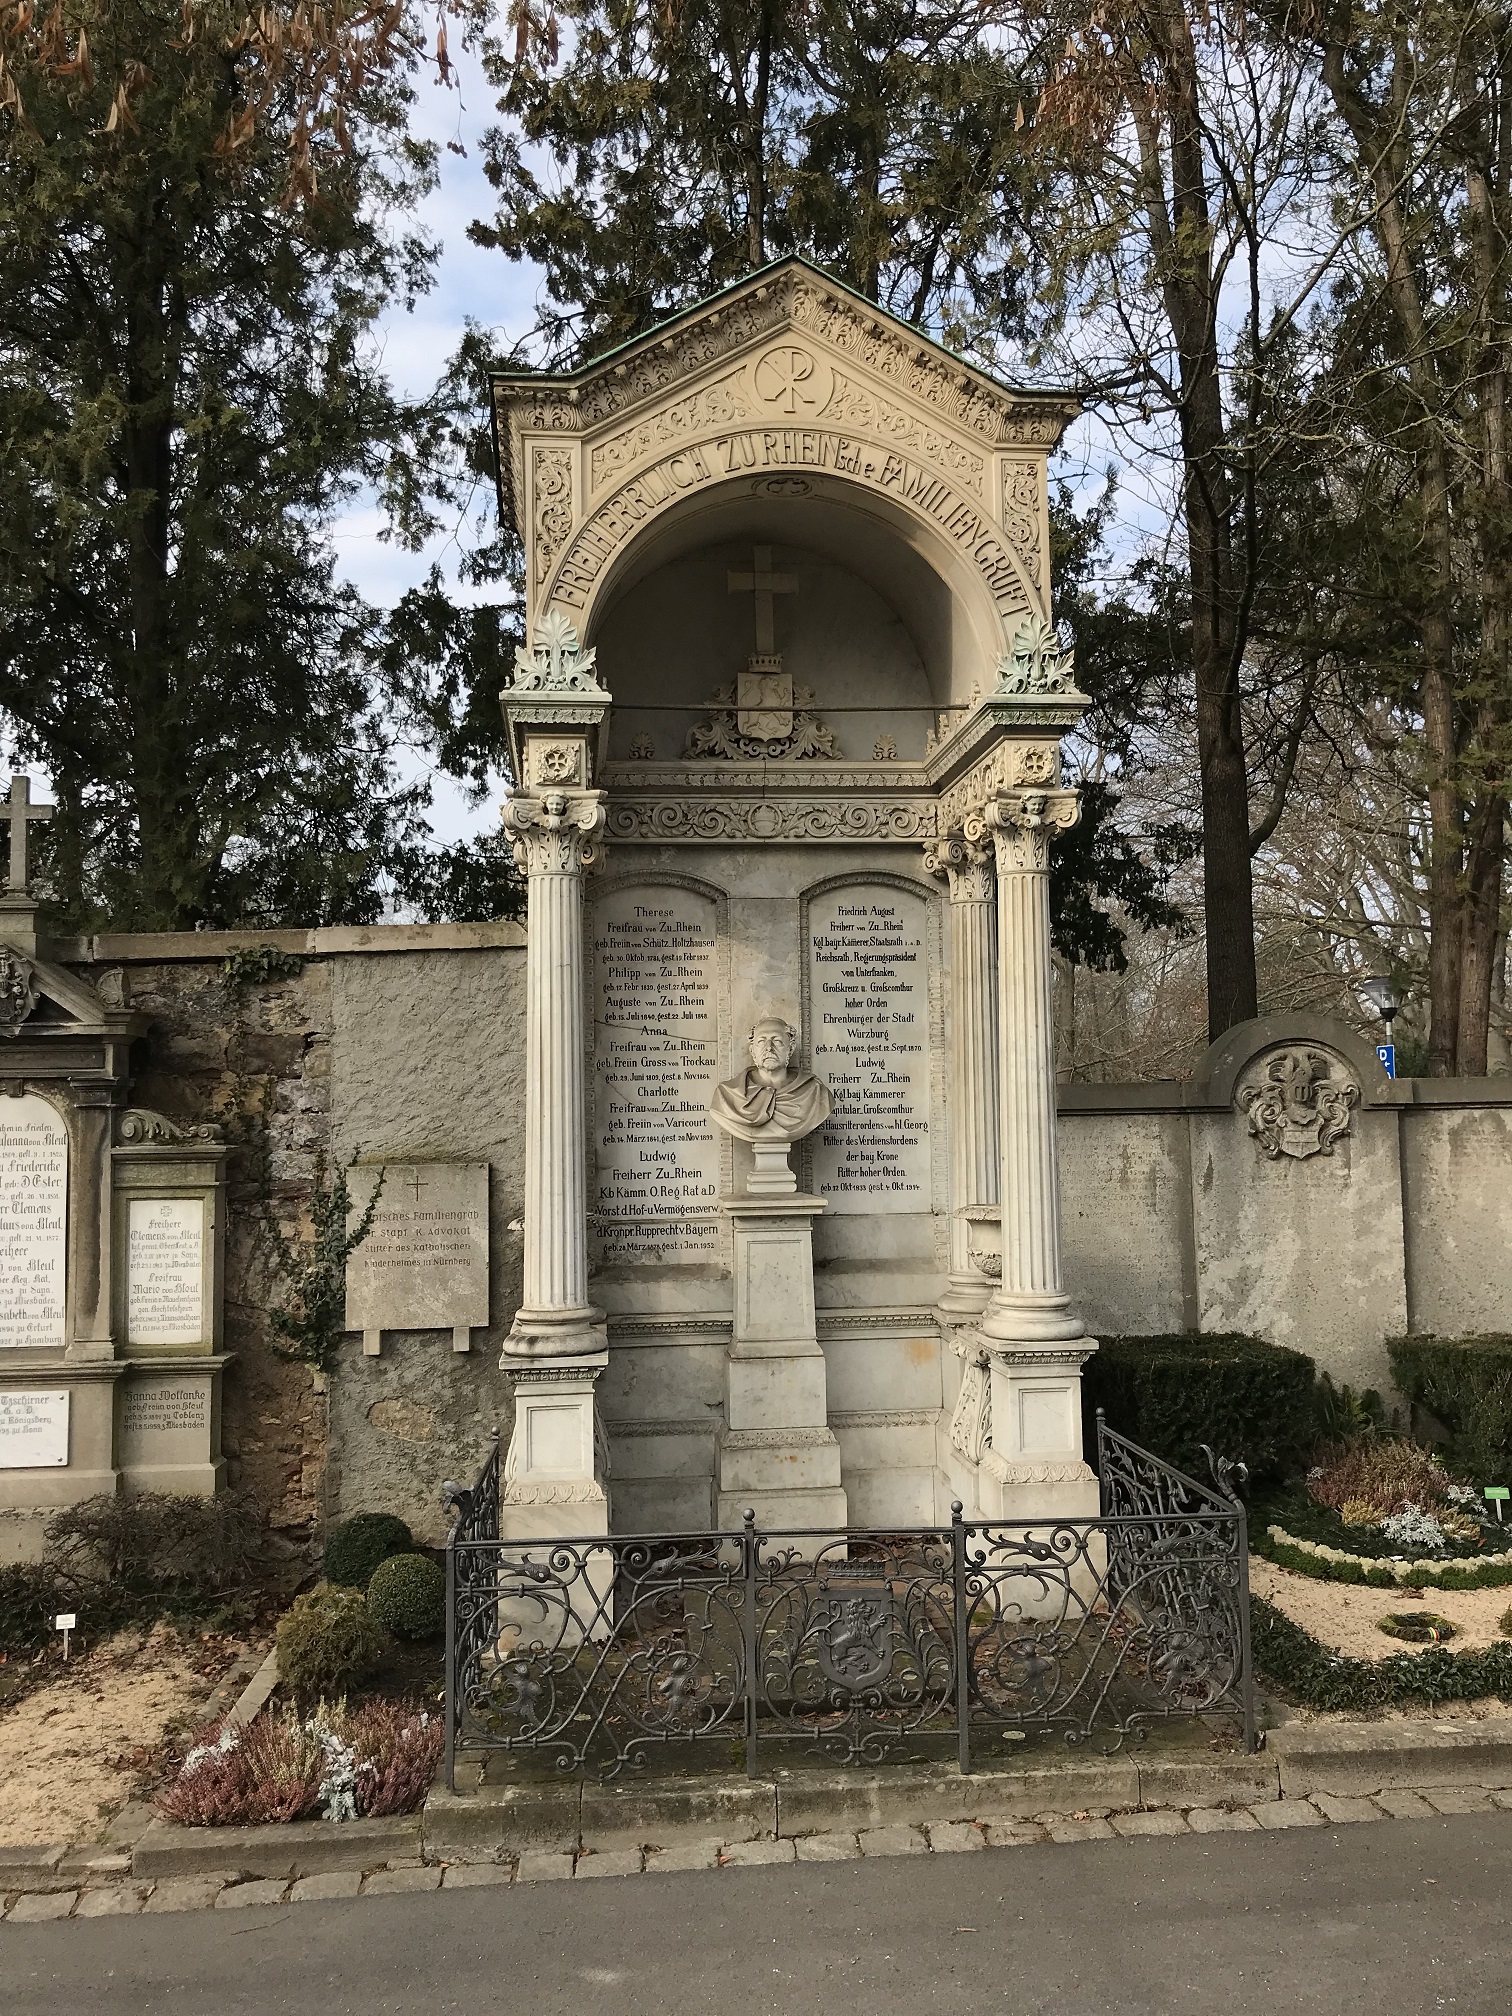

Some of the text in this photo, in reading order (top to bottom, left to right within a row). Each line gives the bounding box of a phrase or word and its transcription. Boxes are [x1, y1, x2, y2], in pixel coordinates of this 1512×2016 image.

[551, 448, 711, 610] FREIHERRLICH
[716, 434, 756, 473] ZU
[873, 455, 1033, 617] FAMILIENGRUFT
[634, 907, 673, 917] Therese
[838, 906, 894, 918] Friedrich August
[608, 922, 642, 932] Freifrau
[830, 922, 854, 931] Freiherr
[595, 938, 609, 950] geb.
[610, 938, 630, 948] Freiin
[870, 936, 902, 946] Staatsrath
[816, 952, 852, 962] Reichsrath,
[609, 967, 640, 980] Philipp
[681, 982, 695, 992] April
[606, 996, 640, 1009] Auguste
[845, 998, 887, 1008] hoher Orden
[605, 1013, 617, 1023] geb.
[626, 1012, 639, 1020] Juli
[681, 1011, 693, 1019] Juli
[824, 1013, 914, 1026] Ehrenbürger der Stadt
[641, 1026, 667, 1035] Anna
[847, 1029, 888, 1041] Würzburg
[611, 1041, 646, 1051] Freifrau
[816, 1045, 829, 1054] geb.
[597, 1058, 612, 1070] geb.
[615, 1057, 637, 1067] Freiin
[641, 1057, 666, 1067] Gross
[681, 1056, 715, 1066] Trockau
[856, 1057, 885, 1070] Ludwig
[606, 1073, 619, 1083] geb.
[829, 1073, 861, 1084] Freiherr
[638, 1086, 678, 1096] Charlotte
[863, 1089, 905, 1098] Kämmerer
[610, 1103, 646, 1113] Freifrau
[609, 1119, 625, 1131] geb.
[628, 1119, 651, 1129] Freiin
[665, 1118, 707, 1127] Varicourt
[826, 1120, 884, 1130] Hausritterordens
[904, 1119, 928, 1133] Georg
[603, 1135, 616, 1146] geb.
[824, 1135, 918, 1146] Ritter des Verdienstordens
[640, 1151, 676, 1164] Ludwig
[846, 1151, 898, 1162] der Krone
[613, 1169, 651, 1180] Freiherr
[838, 1167, 859, 1177] Ritter
[860, 1166, 881, 1177] hoher
[617, 1187, 648, 1198] Kämm.
[683, 1185, 698, 1196] Rat
[12, 1201, 52, 1214] Clemens
[414, 1211, 479, 1221] Familiengrab
[148, 1219, 181, 1231] Freiherr
[636, 1224, 677, 1238] Rupprecht
[686, 1223, 718, 1237] Bayern
[131, 1231, 166, 1240] Clemens
[381, 1227, 470, 1239] Stapf Advokat
[396, 1244, 410, 1252] des
[627, 1243, 646, 1251] März
[27, 1258, 54, 1271] Bleul
[433, 1259, 471, 1267] Nürnberg
[148, 1273, 182, 1282] Freifrau
[133, 1284, 160, 1294] Marie
[174, 1283, 199, 1293] Bleul
[27, 1323, 52, 1331] Erfurt
[1, 1395, 49, 1406] Tzschirner
[125, 1390, 205, 1402] Hanna Wollanke
[182, 1402, 204, 1410] Bleul
[173, 1412, 205, 1420] Coblenz
[166, 1420, 205, 1429] Wiesbaden
